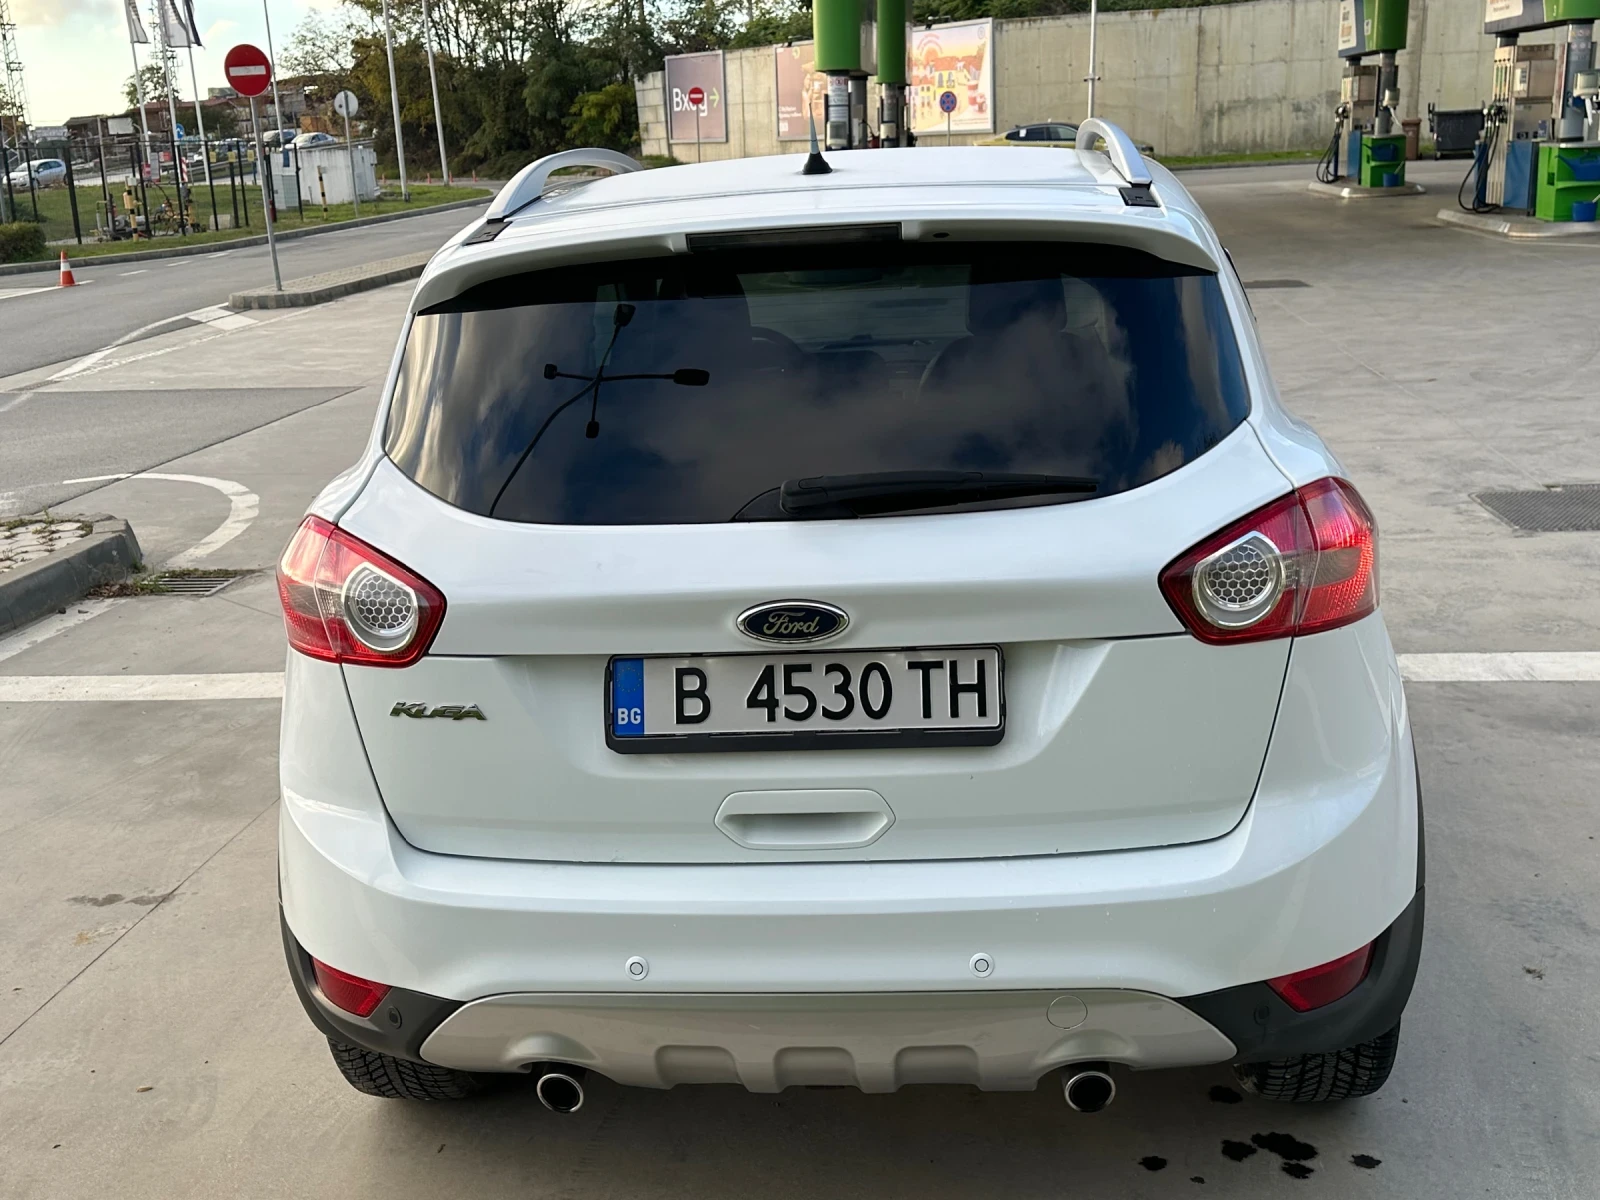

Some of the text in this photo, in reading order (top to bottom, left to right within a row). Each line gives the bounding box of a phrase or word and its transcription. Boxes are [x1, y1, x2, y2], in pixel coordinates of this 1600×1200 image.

[763, 611, 820, 635] Ford
[674, 659, 988, 726] B 4530 TH
[389, 701, 488, 721] KUGA
[617, 707, 642, 726] BG
